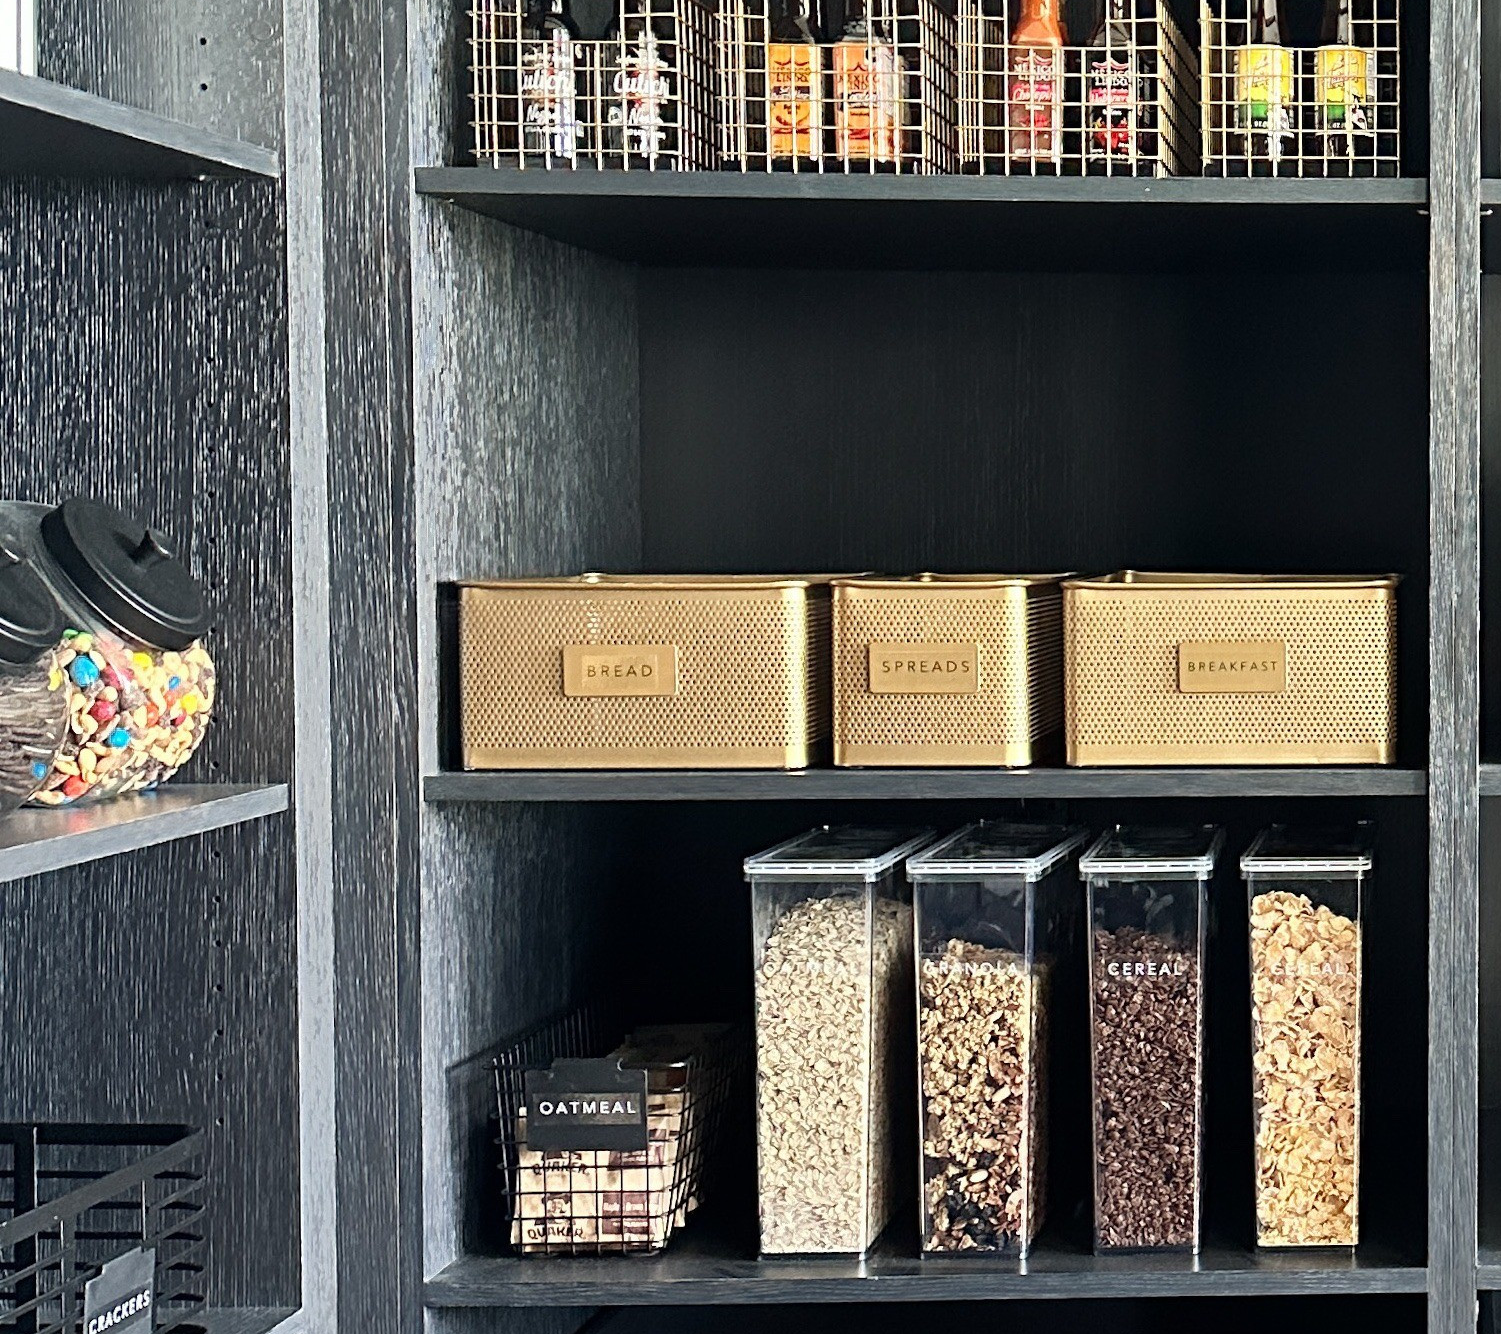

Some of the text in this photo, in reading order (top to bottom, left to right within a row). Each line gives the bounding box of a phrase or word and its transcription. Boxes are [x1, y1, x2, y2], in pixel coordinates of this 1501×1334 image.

[587, 663, 654, 679] BREAD
[882, 659, 972, 674] SPREADS
[1186, 659, 1278, 673] BREAKFAST
[922, 960, 1019, 976] GRANOLA
[1107, 961, 1184, 977] CEREAL
[1270, 961, 1347, 977] CEREAL
[538, 1100, 638, 1116] OATMEAL
